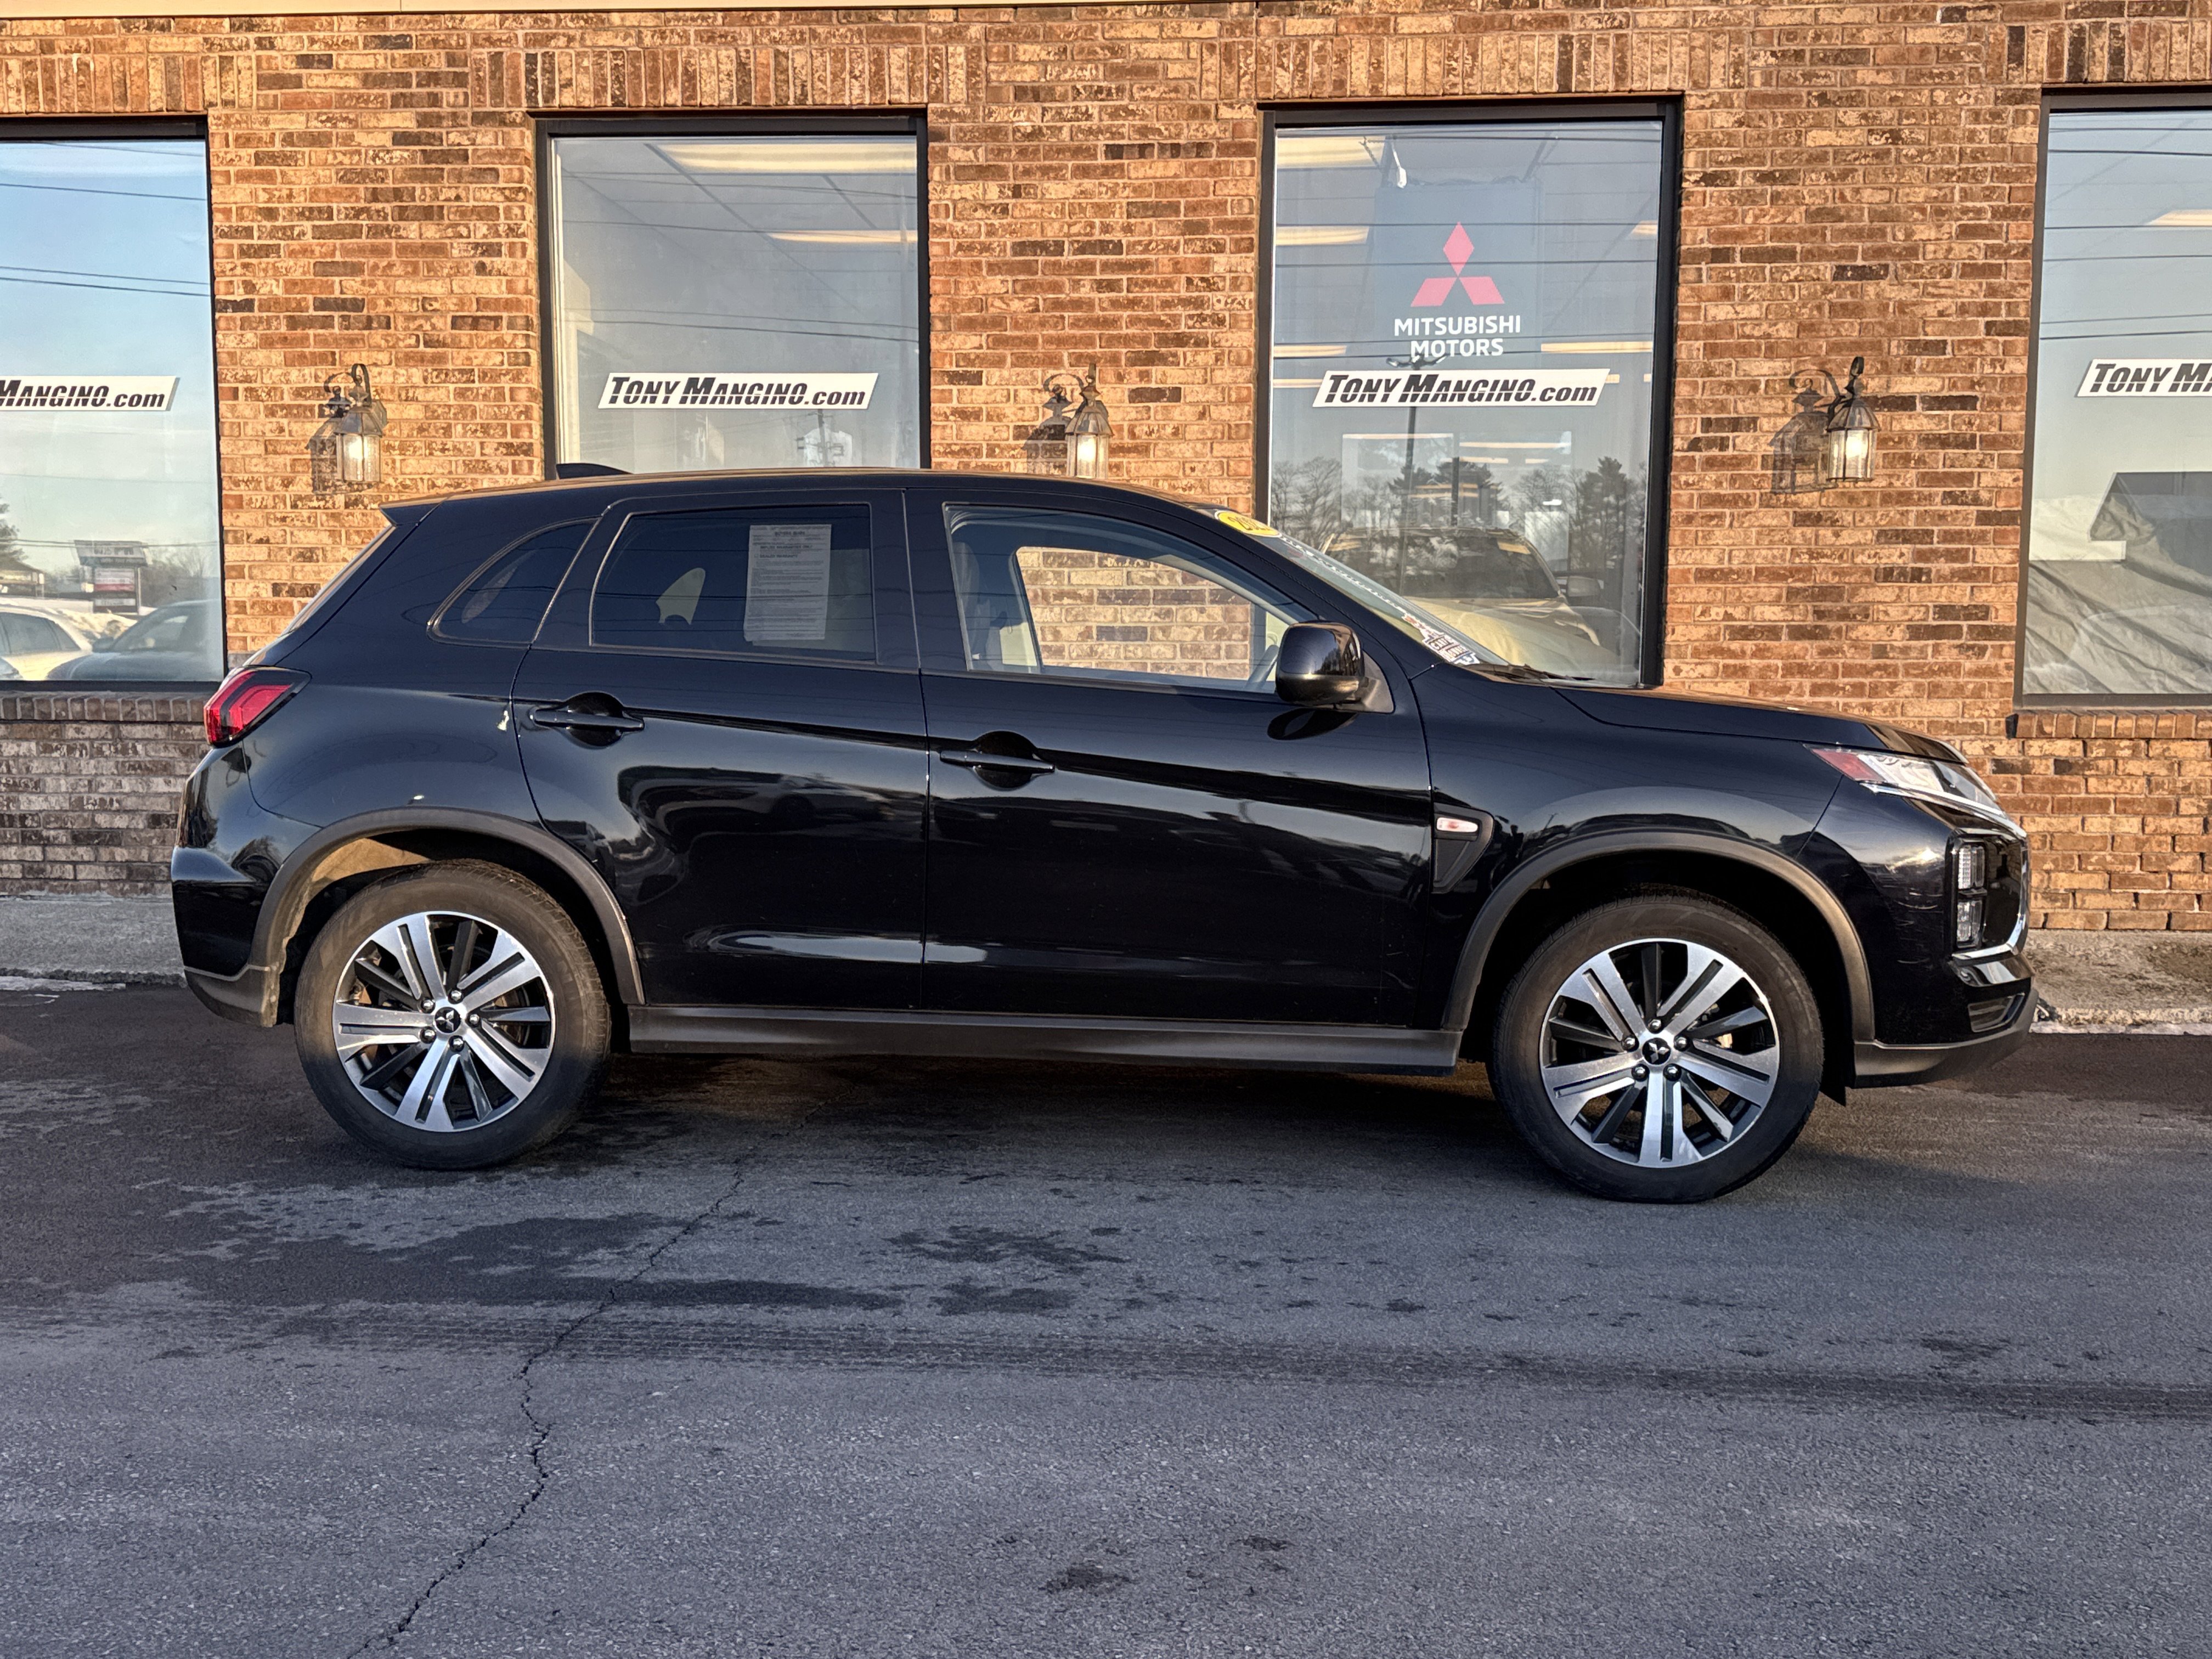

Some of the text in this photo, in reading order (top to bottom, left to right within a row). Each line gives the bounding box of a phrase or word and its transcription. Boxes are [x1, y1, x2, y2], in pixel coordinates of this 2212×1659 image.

[1394, 315, 1521, 336] MITSUBISHI
[1410, 338, 1504, 358] MOTORS
[608, 377, 681, 404] TONY
[1325, 375, 1402, 403] TONY
[2090, 363, 2172, 393] TONY
